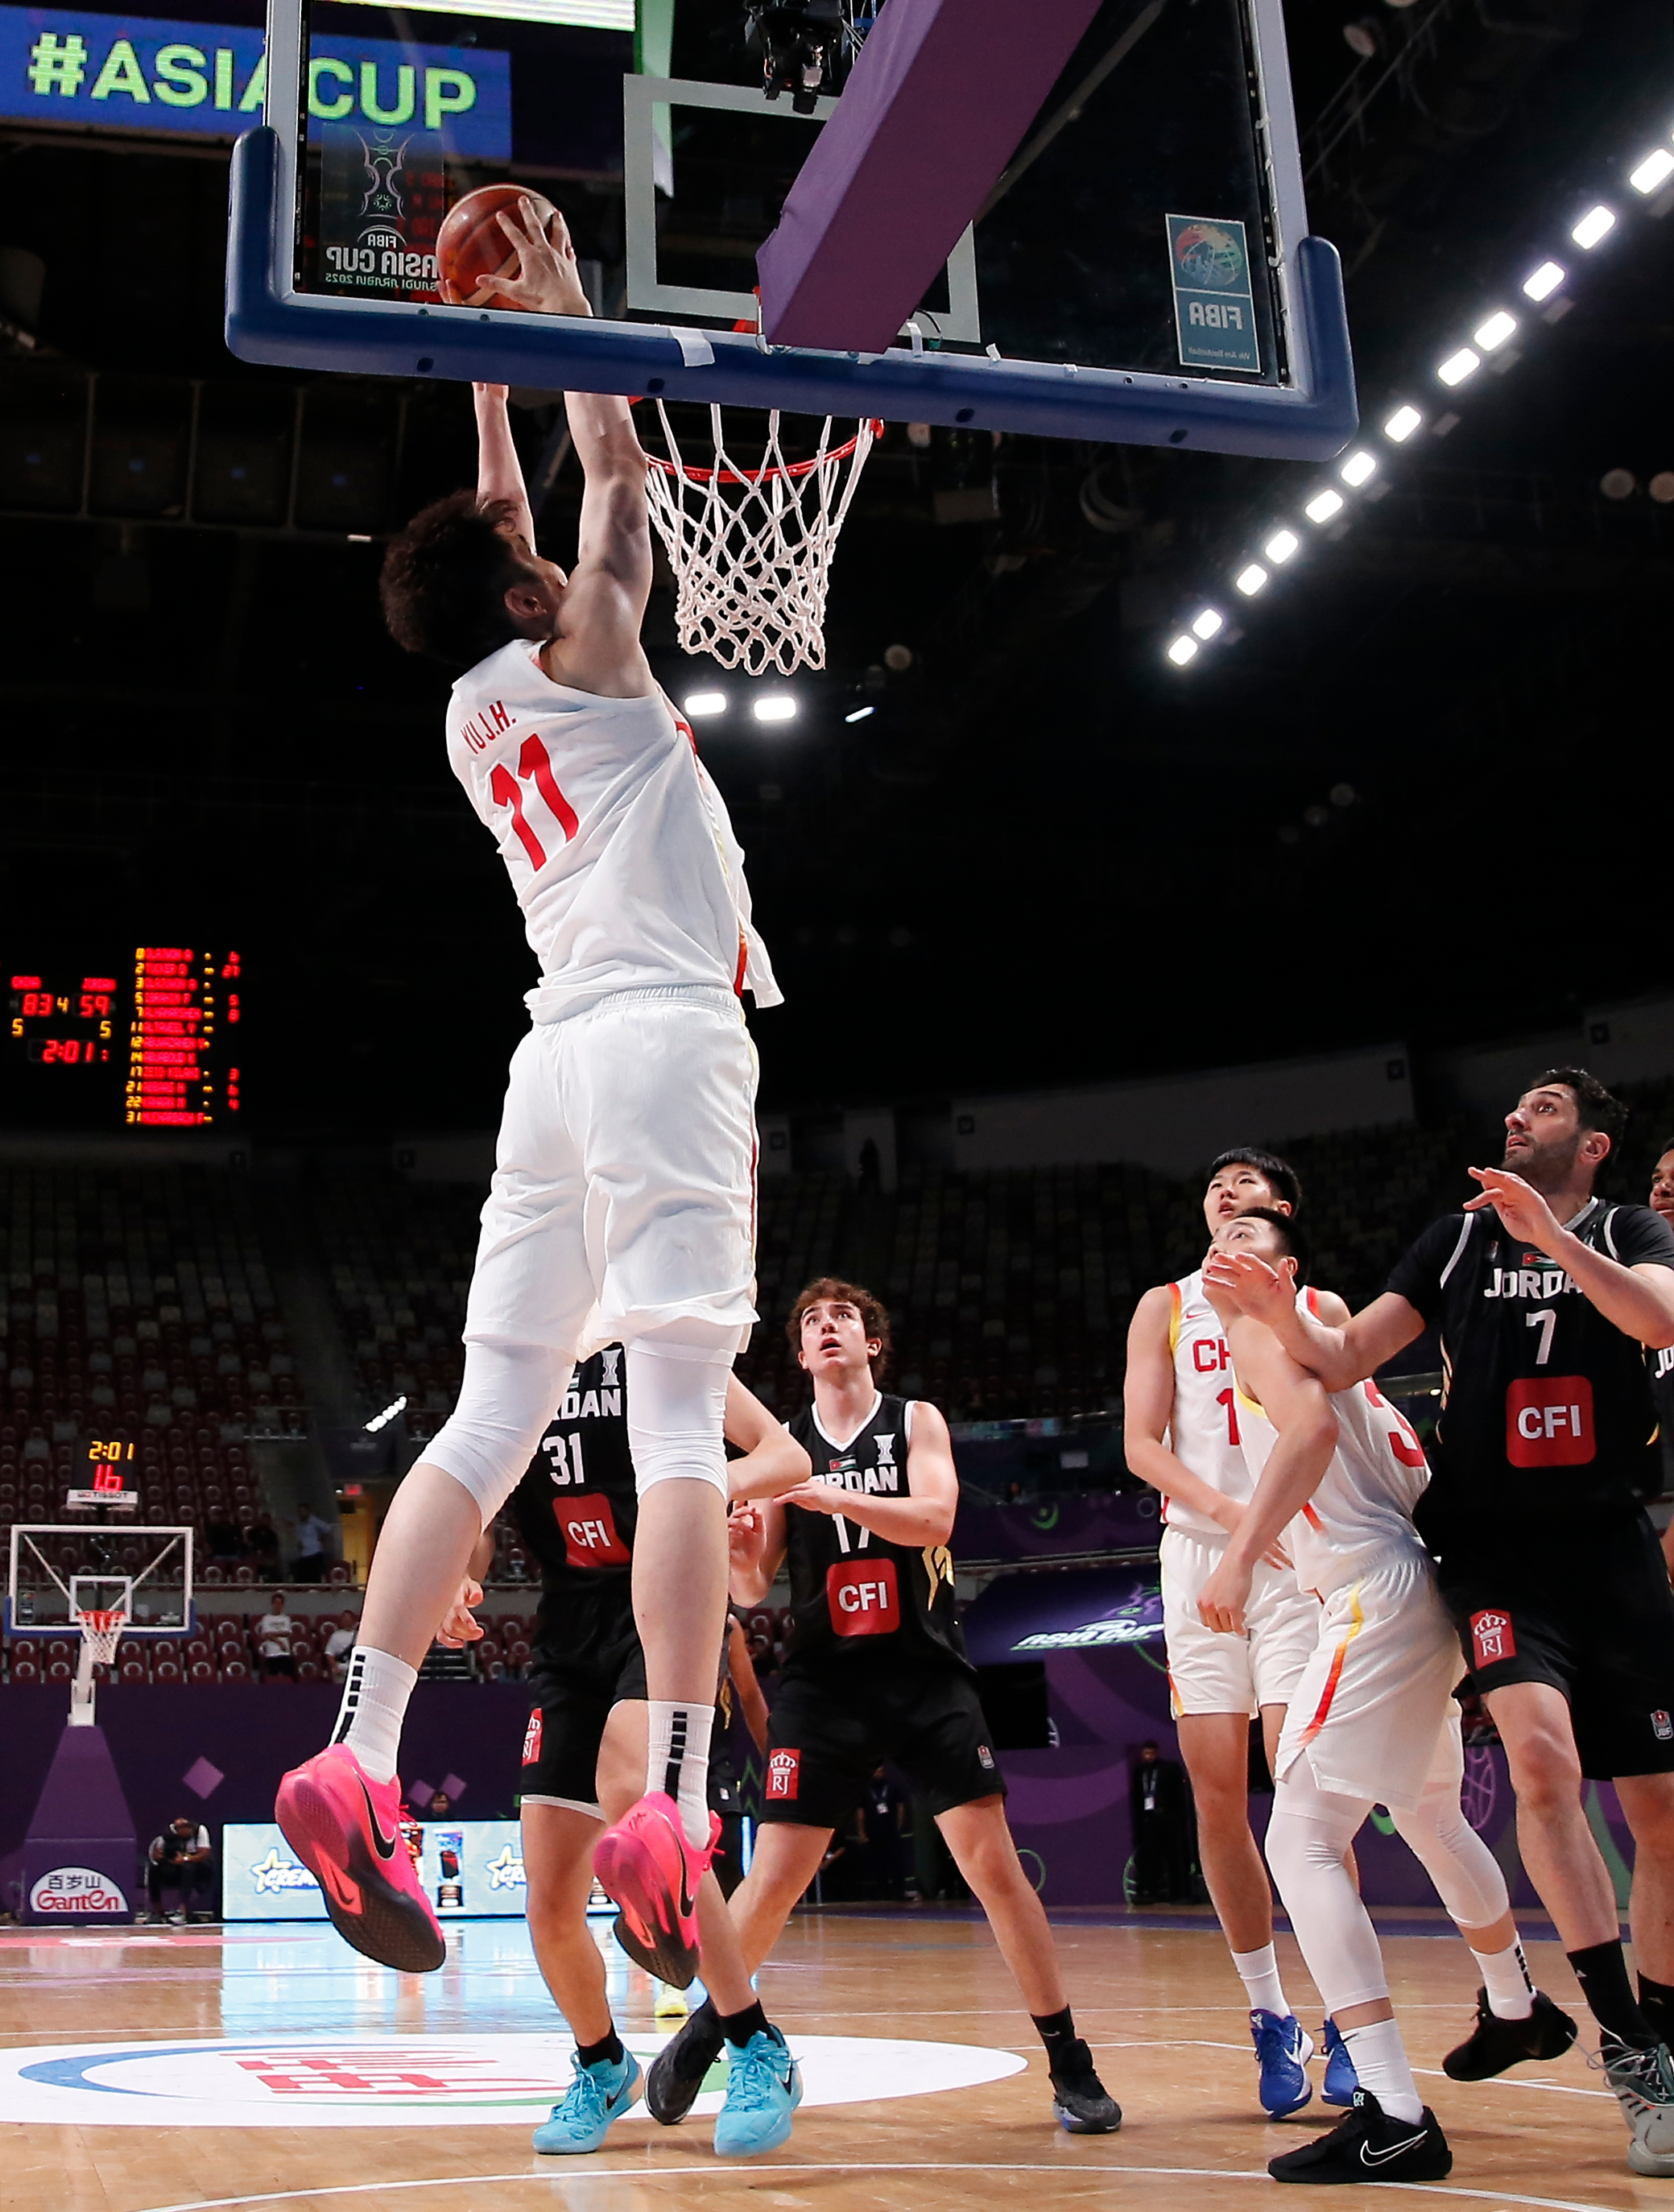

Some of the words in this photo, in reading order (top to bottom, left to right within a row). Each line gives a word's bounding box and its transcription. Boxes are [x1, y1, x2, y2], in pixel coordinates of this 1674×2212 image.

[477, 700, 518, 741] J.H.
[490, 733, 579, 872] 11
[23, 993, 54, 1017] 83
[57, 997, 69, 1015] 4
[80, 994, 110, 1018] 59
[11, 1019, 24, 1038] 5
[99, 1020, 112, 1040] 5
[42, 1040, 95, 1063] 2:01
[1525, 1309, 1557, 1365] 7
[1517, 1404, 1581, 1440] CFI
[89, 1440, 134, 1462] 2:01
[543, 1432, 585, 1486] 31
[567, 1519, 612, 1548] CFI
[838, 1581, 888, 1613] CFI
[1482, 1634, 1503, 1657] RJ
[523, 1739, 534, 1761] RJ
[772, 1775, 788, 1796] RJ
[48, 1874, 101, 1890] 百岁山
